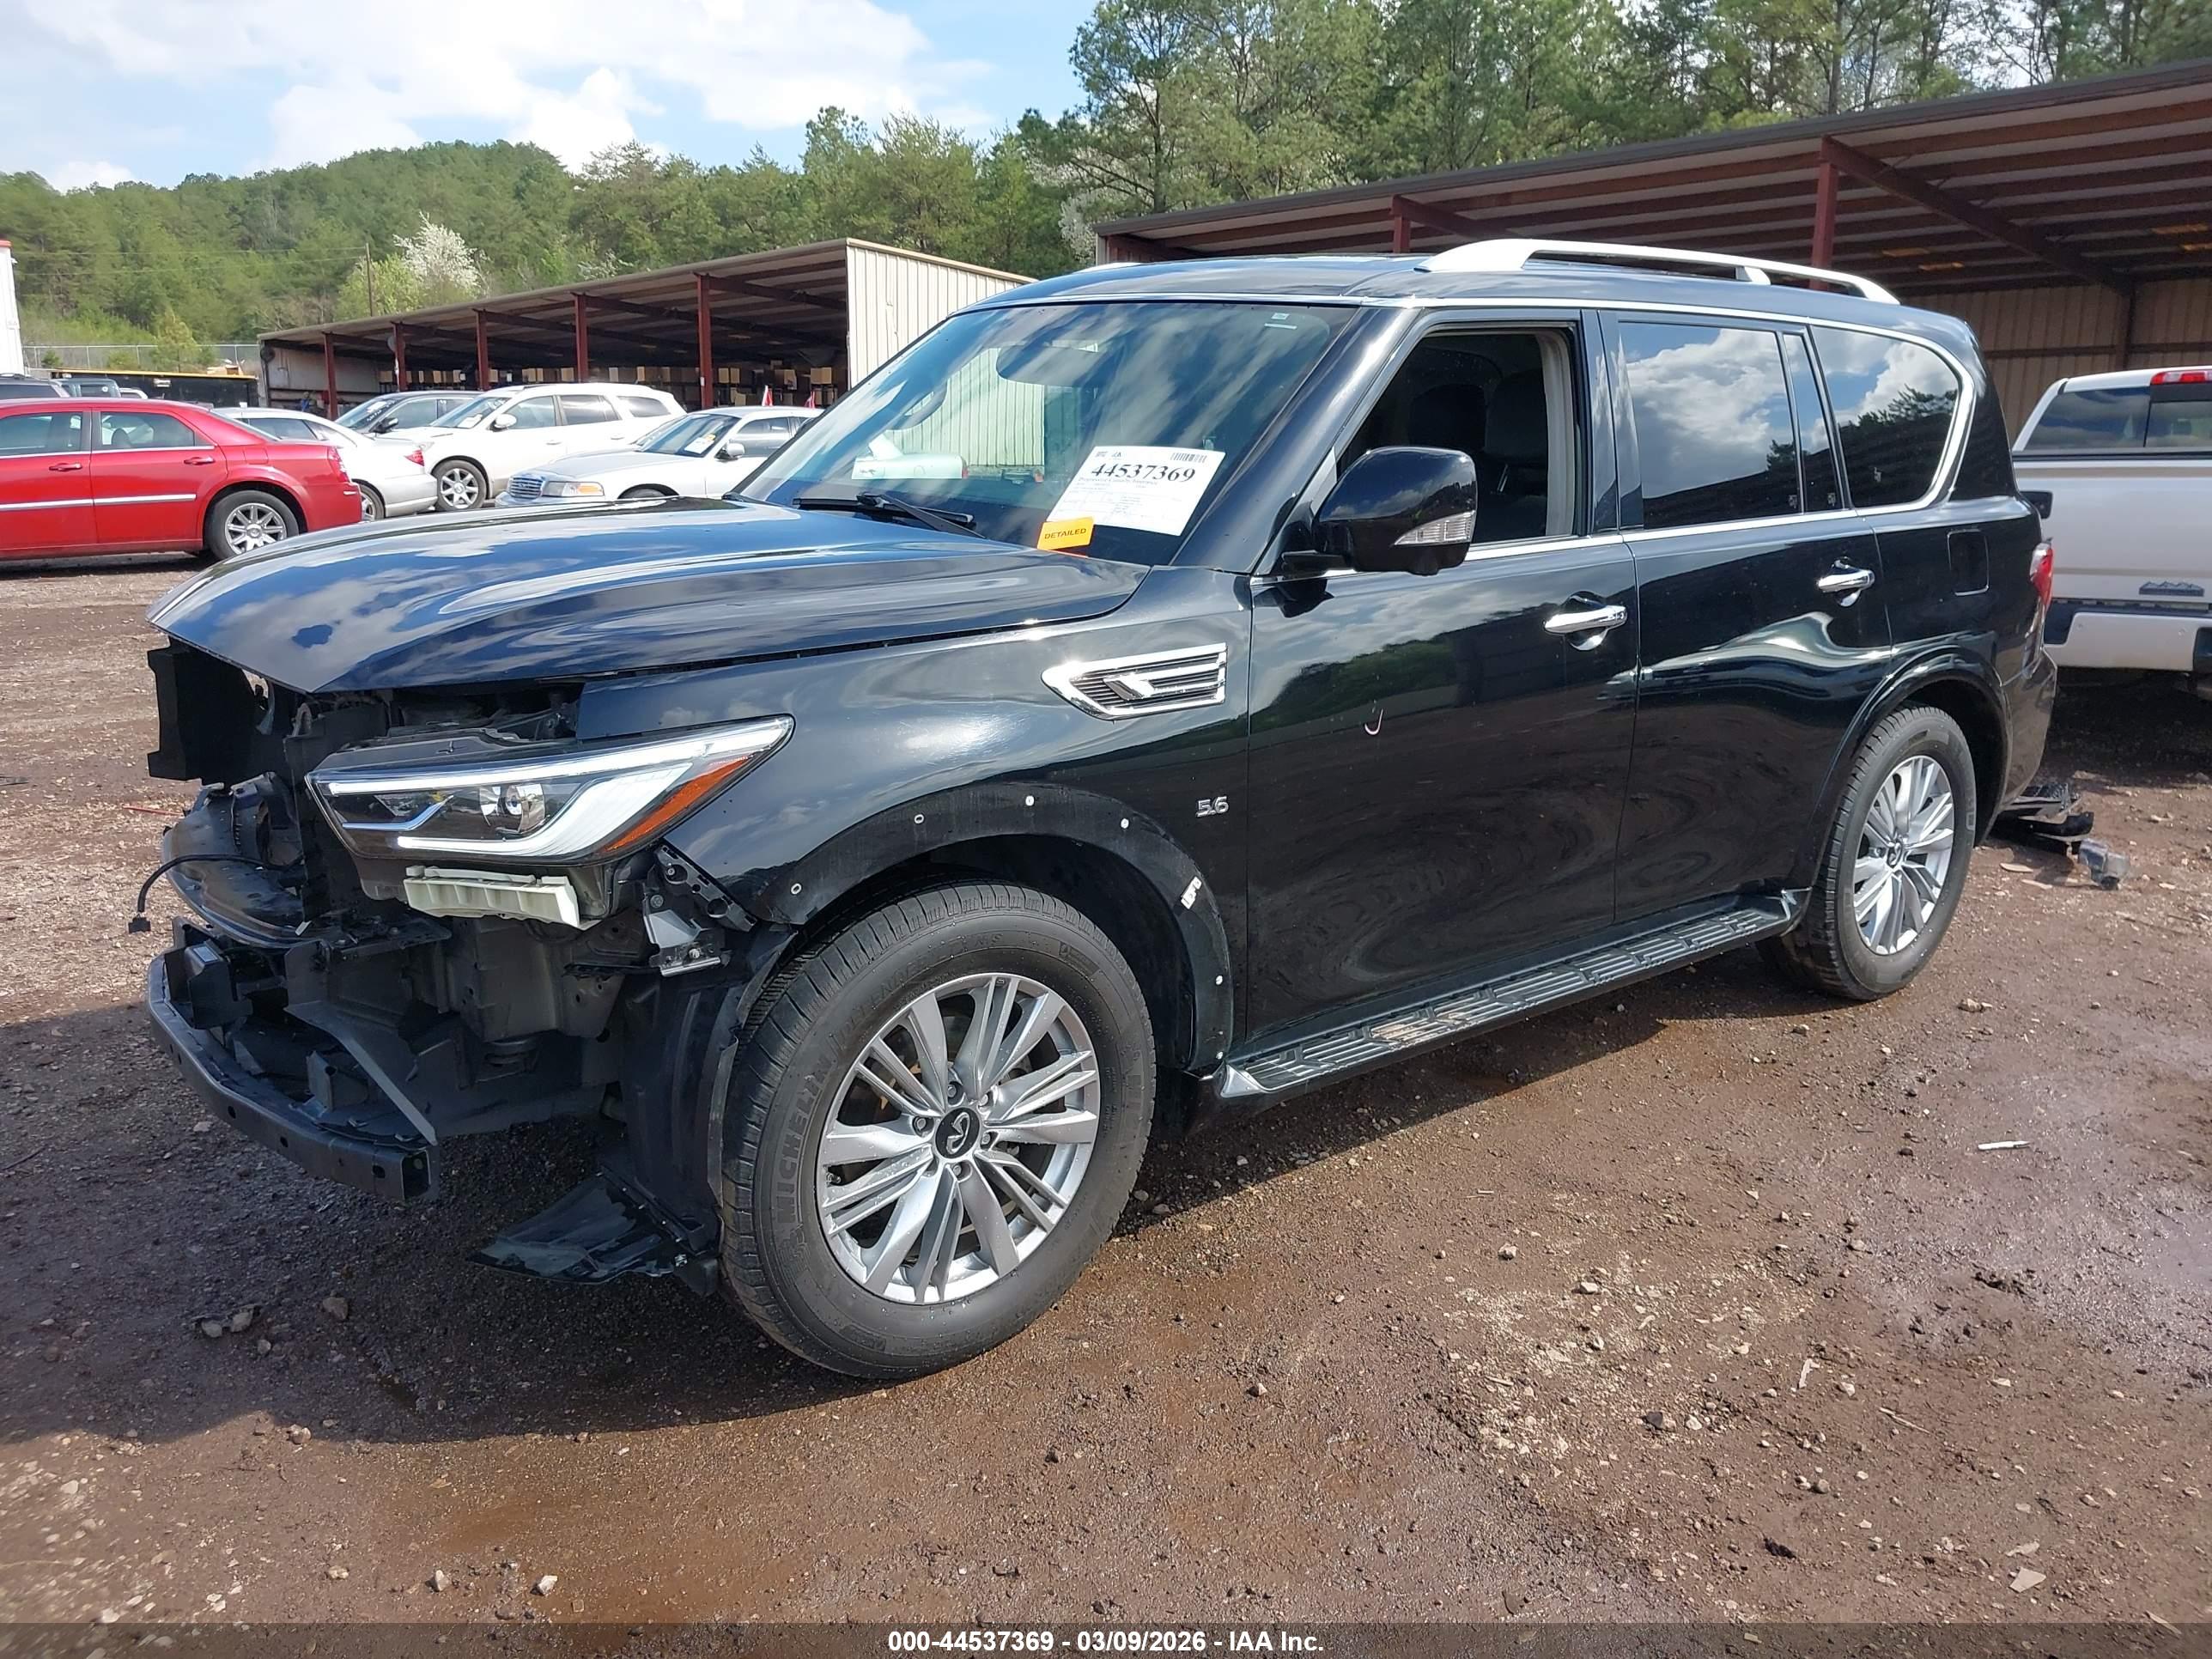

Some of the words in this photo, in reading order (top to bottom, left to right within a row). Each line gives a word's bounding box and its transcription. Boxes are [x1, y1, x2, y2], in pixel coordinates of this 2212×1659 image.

[1091, 462, 1195, 483] 44537369
[1043, 527, 1087, 540] DETAILED
[775, 1054, 835, 1224] MICHELIN
